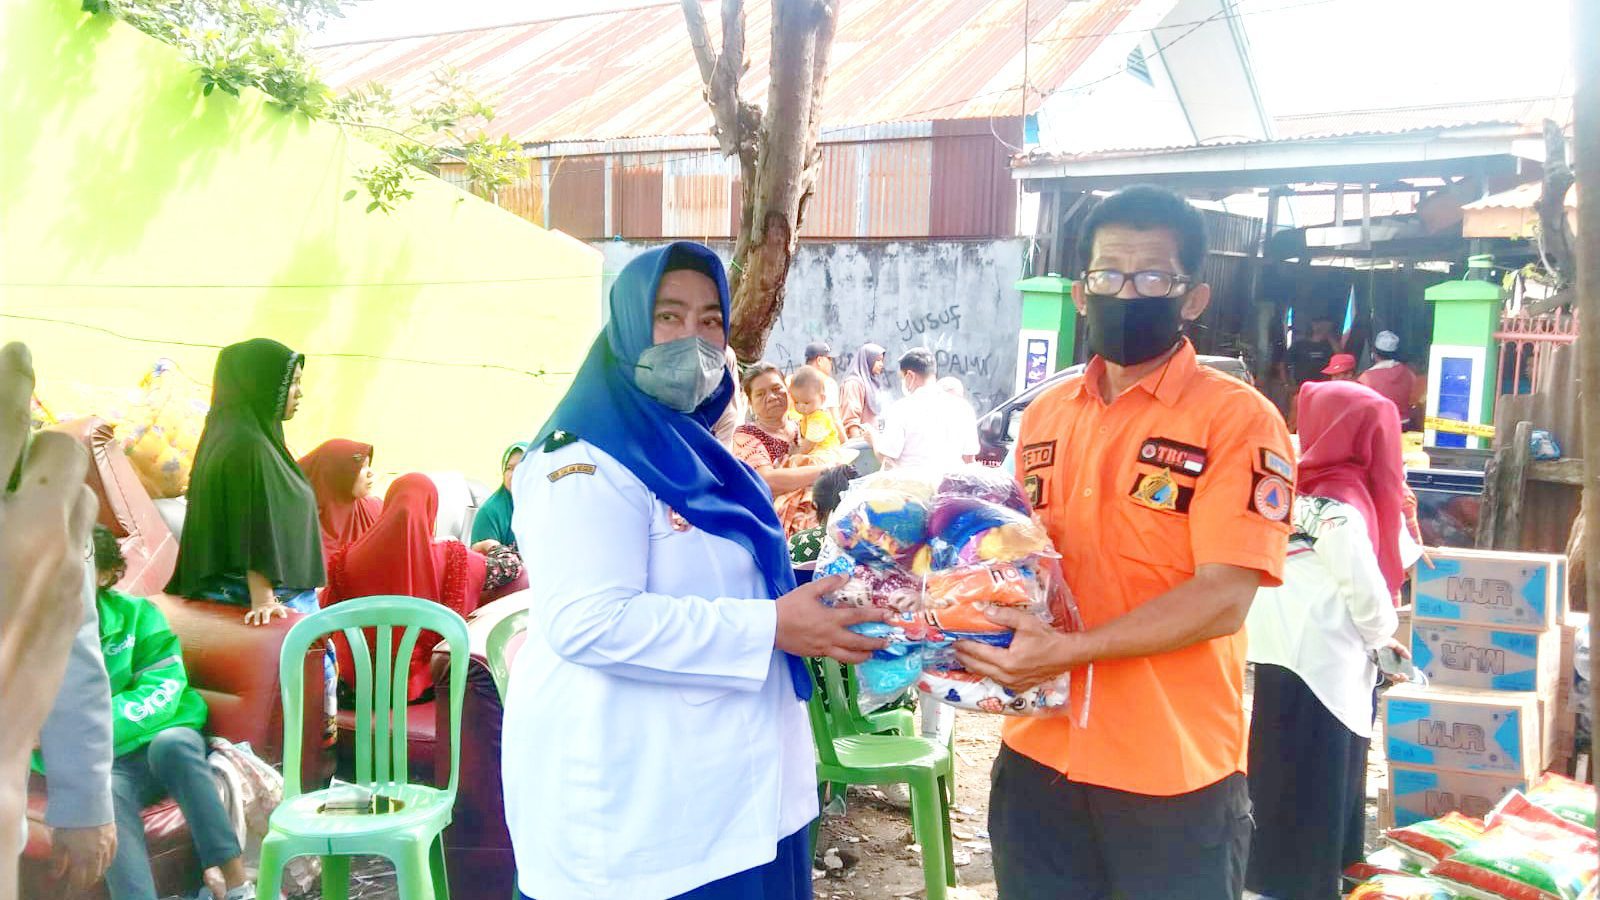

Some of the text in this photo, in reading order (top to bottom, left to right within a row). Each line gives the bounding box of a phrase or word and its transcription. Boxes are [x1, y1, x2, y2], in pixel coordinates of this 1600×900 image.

[1023, 449, 1050, 465] ETO
[1157, 446, 1188, 467] TRC
[1446, 576, 1513, 607] MJR
[124, 679, 180, 722] Grab
[1417, 718, 1486, 752] MJR
